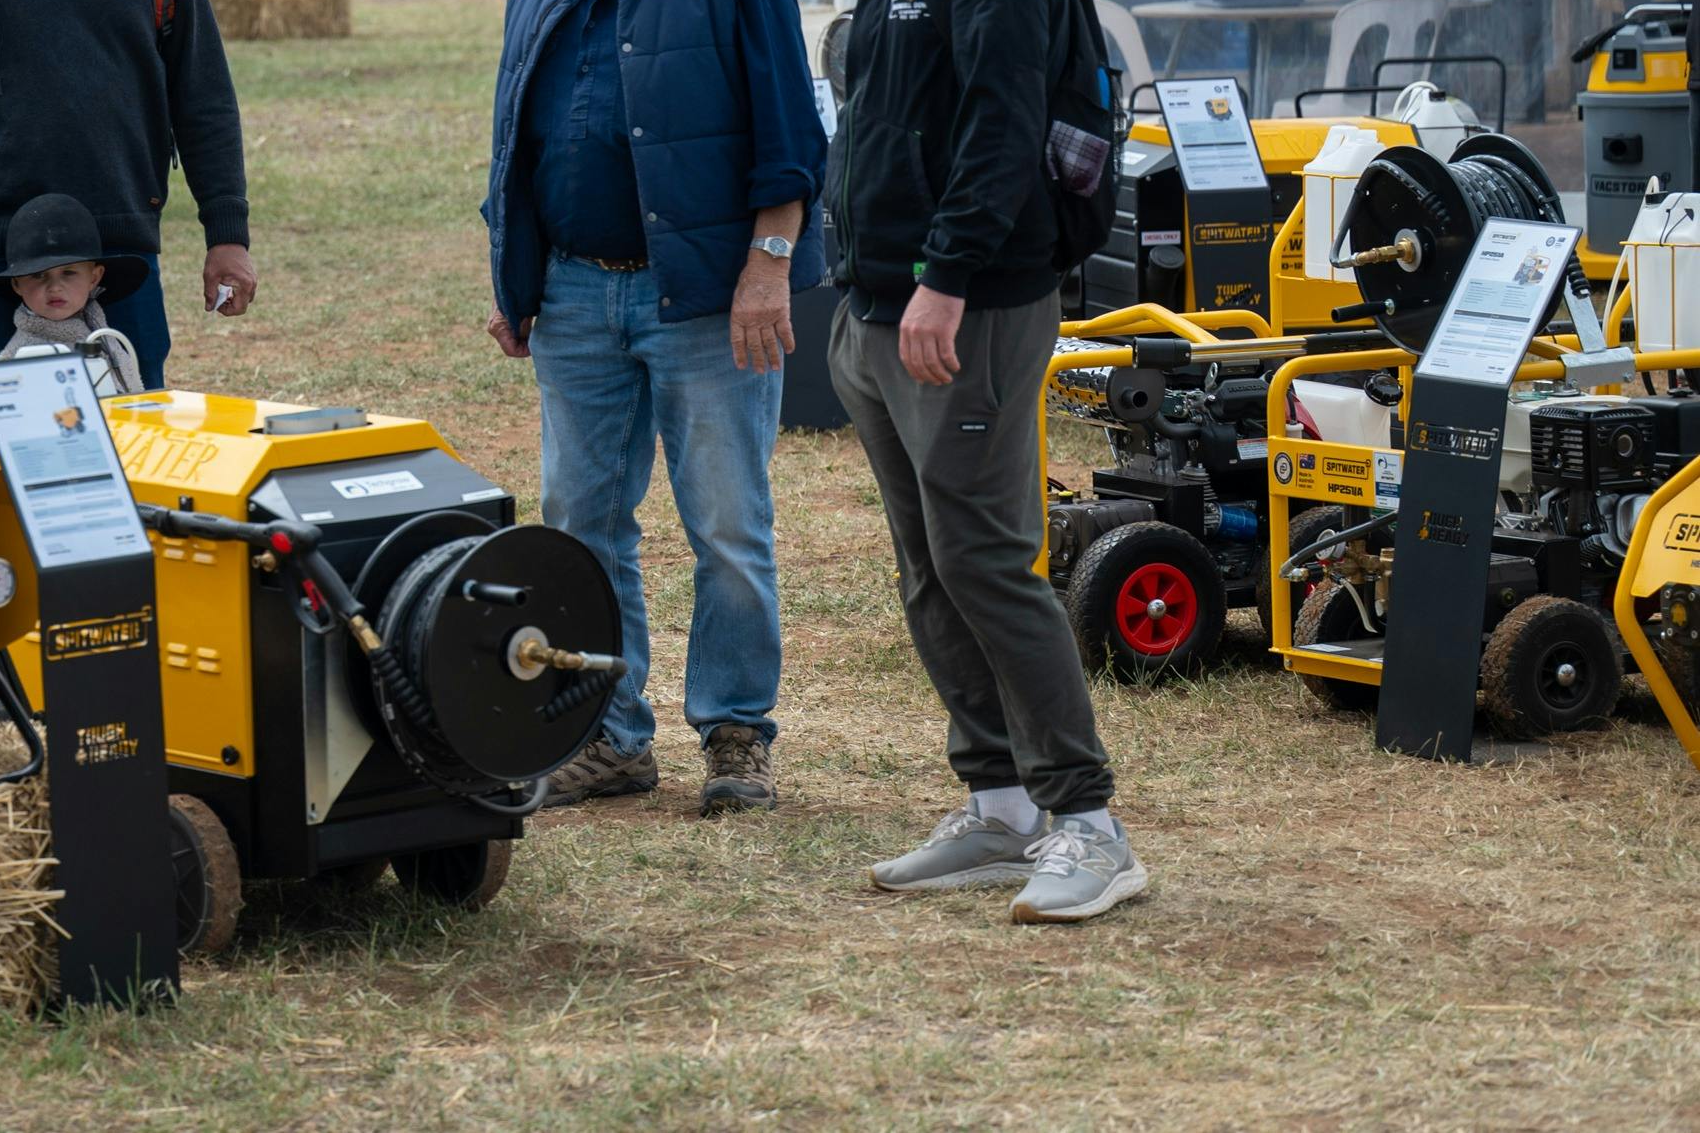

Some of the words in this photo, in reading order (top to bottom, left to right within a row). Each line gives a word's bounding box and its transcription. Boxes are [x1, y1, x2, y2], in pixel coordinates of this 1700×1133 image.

[1594, 180, 1646, 193] VACSTOR
[1326, 461, 1365, 476] SPITWATER
[55, 621, 141, 651] SPITWATER
[77, 721, 126, 746] TOUGH
